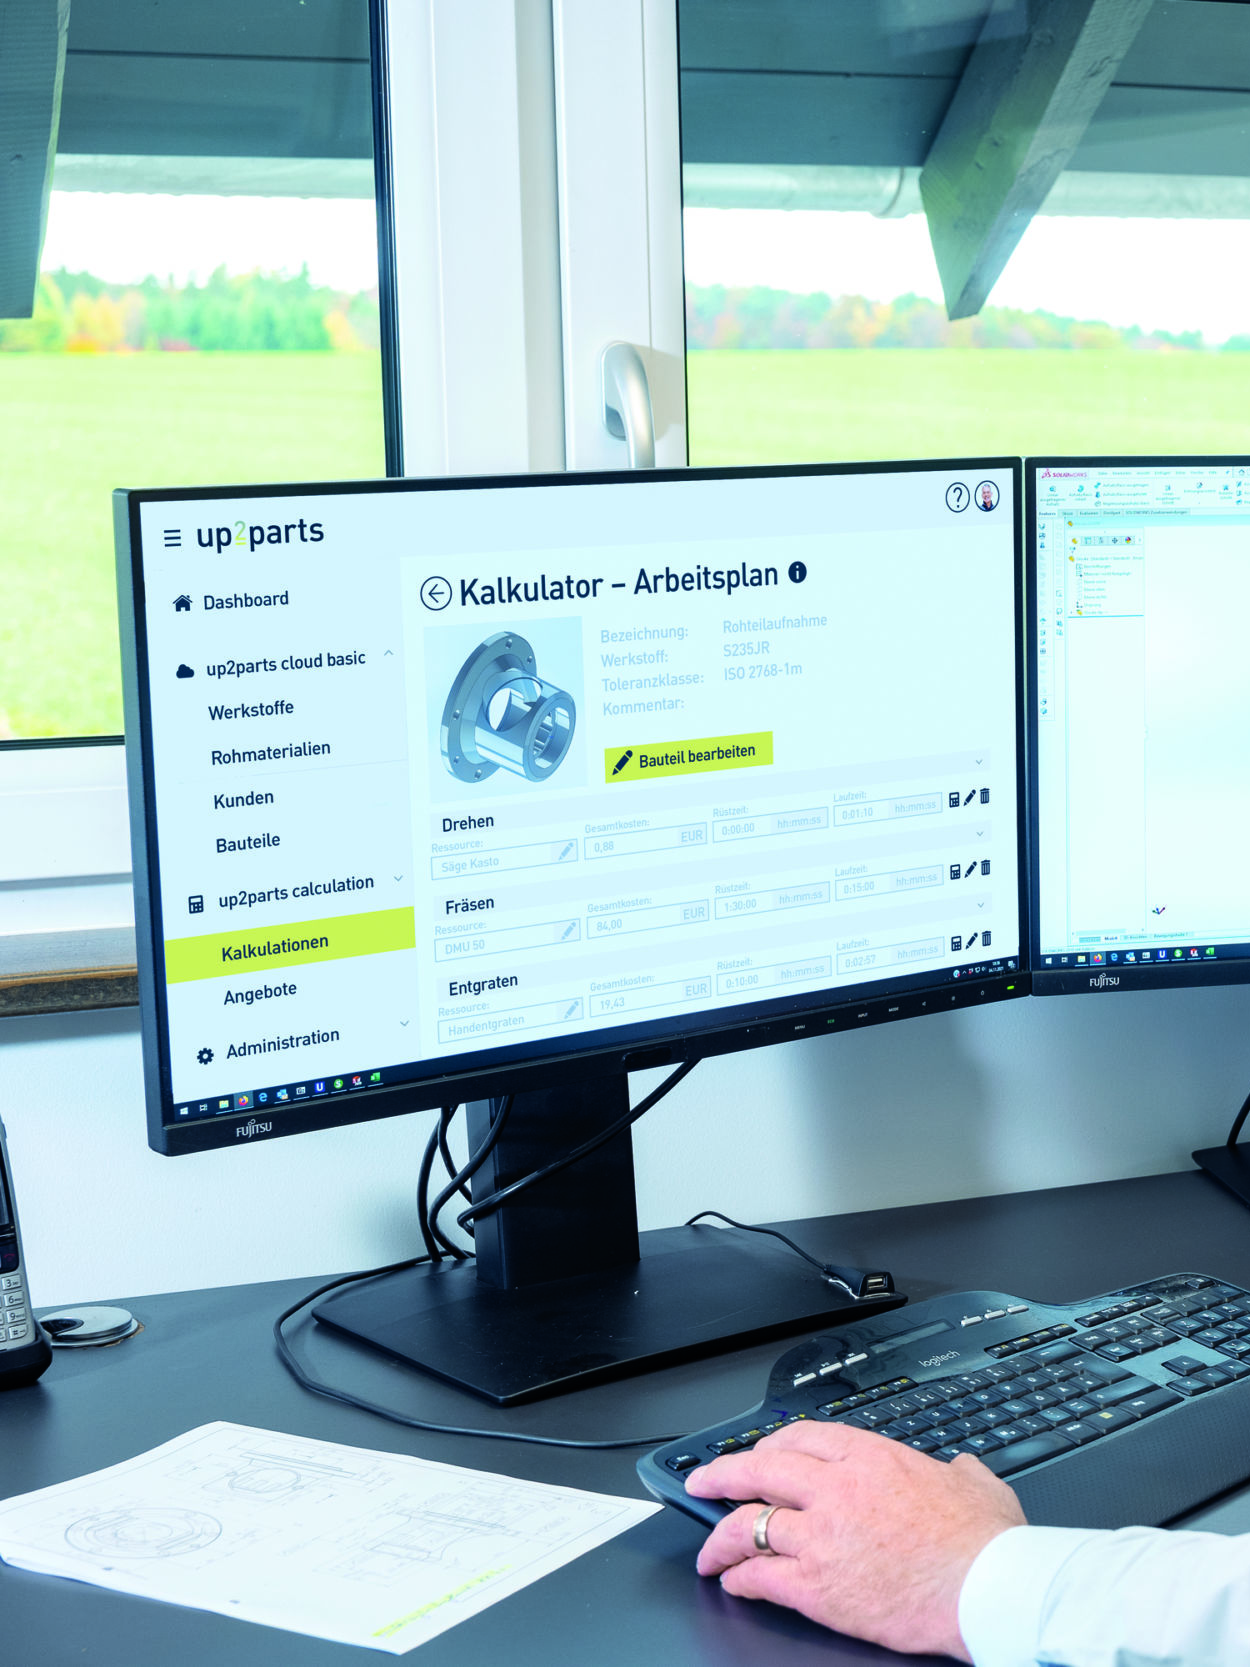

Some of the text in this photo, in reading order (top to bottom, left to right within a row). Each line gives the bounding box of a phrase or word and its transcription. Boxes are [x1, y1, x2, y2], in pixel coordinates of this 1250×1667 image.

[197, 518, 325, 553] up2parts
[459, 574, 605, 609] Kalkulator
[633, 561, 779, 602] Arbeitsplan
[203, 589, 290, 611] Dashboard
[722, 612, 829, 634] Rohteilaufnahme
[600, 624, 689, 646] Bezeichnung:
[722, 640, 771, 658] S235JR
[206, 649, 367, 681] up2parts cloud basic
[601, 648, 669, 670] Werkstoff:
[723, 661, 803, 681] ISO 2768-1m
[602, 670, 705, 693] Toleranzklasse:
[208, 699, 295, 722] Werkstoffe
[602, 697, 685, 717] Kommentar:
[211, 740, 331, 766] Rohmaterialien
[639, 743, 756, 770] Bauteil bearbeiten
[213, 789, 275, 811] Kunden
[833, 790, 867, 803] Laufzeit:
[713, 805, 749, 818] Rüstzeit:
[895, 800, 936, 814] hh:mm:ss
[442, 815, 495, 834] Drehen
[584, 817, 650, 834] Gesamtkosten:
[722, 815, 821, 836] 0:00:00 hh:mm:ss
[216, 831, 281, 854] Bauteile
[431, 838, 484, 854] Ressource:
[594, 829, 703, 854] 0,88 EUR
[441, 855, 499, 874] Säge Kasto
[835, 865, 868, 877] Laufzeit:
[715, 881, 751, 895] Rüstzeit:
[896, 873, 937, 887] hh:mm:ss
[218, 874, 375, 909] up2parts calculation
[779, 890, 823, 905] hh:mm:ss
[445, 896, 495, 915] Fräsen
[587, 896, 652, 914] Gesamtkosten:
[434, 920, 487, 936] Ressource:
[596, 906, 706, 932] 84,00 EUR
[221, 933, 329, 962] Kalkulationen
[445, 939, 485, 955] DMU 50
[836, 938, 870, 951] Laufzeit:
[897, 943, 938, 959] hh:mm:ss
[717, 958, 753, 972] Rüstzeit:
[780, 964, 825, 980] hh:mm:ss
[449, 974, 518, 997] Entgraten
[590, 973, 655, 992] Gesamtkosten:
[1089, 972, 1120, 988] FUJITSU
[223, 981, 298, 1006] Angebote
[685, 983, 707, 997] EUR
[438, 1001, 490, 1017] Ressource:
[448, 1014, 525, 1037] Handentgraten
[226, 1028, 340, 1060] Administration
[236, 1118, 272, 1138] FUJITSU
[918, 1350, 961, 1367] logitech
